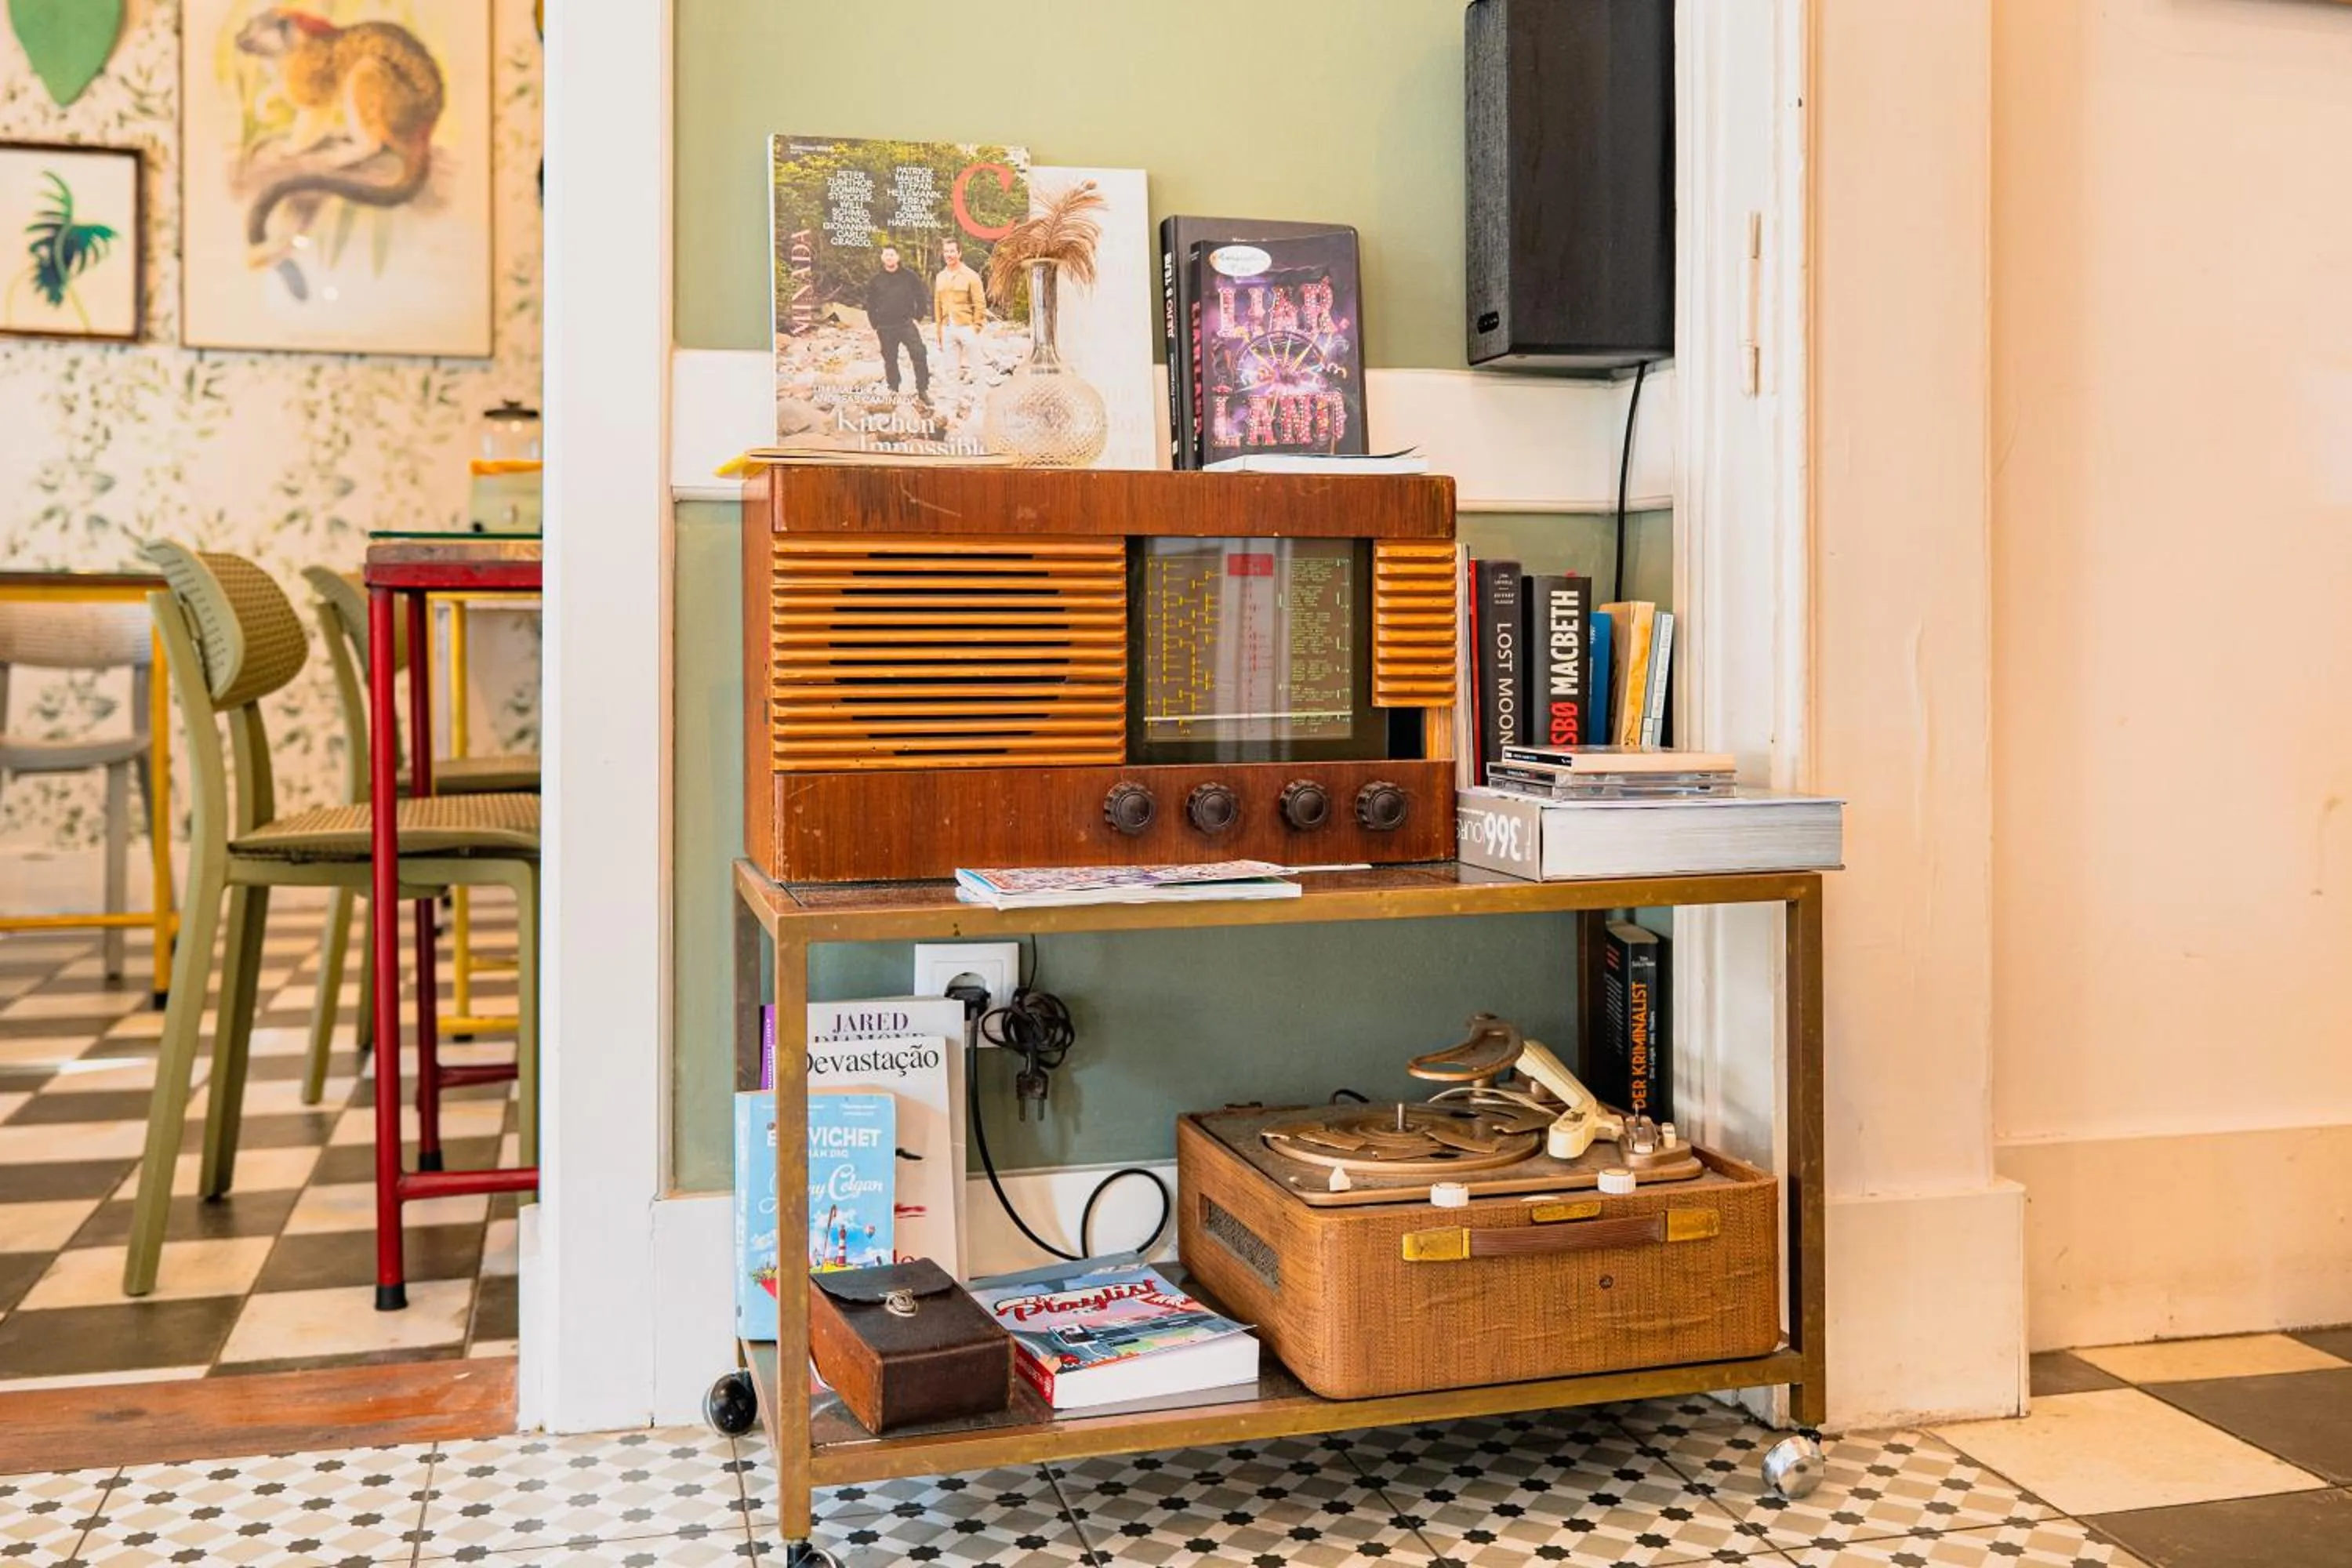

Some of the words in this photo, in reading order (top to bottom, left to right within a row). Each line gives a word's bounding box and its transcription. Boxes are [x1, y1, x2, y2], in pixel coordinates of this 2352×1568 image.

[1216, 279, 1338, 338] LIAR
[836, 408, 935, 434] Kitchen
[1212, 391, 1347, 448] LAND
[1497, 623, 1512, 672] LOST
[1550, 590, 1579, 695] MACBETH
[1497, 679, 1514, 746] MOON
[1550, 701, 1579, 746] SBØ
[1484, 811, 1522, 862] 366
[833, 1012, 909, 1033] JARED
[1631, 981, 1647, 1075] KRIMINALIST
[1631, 1079, 1647, 1109] DER
[996, 1279, 1159, 1321] Playlist
